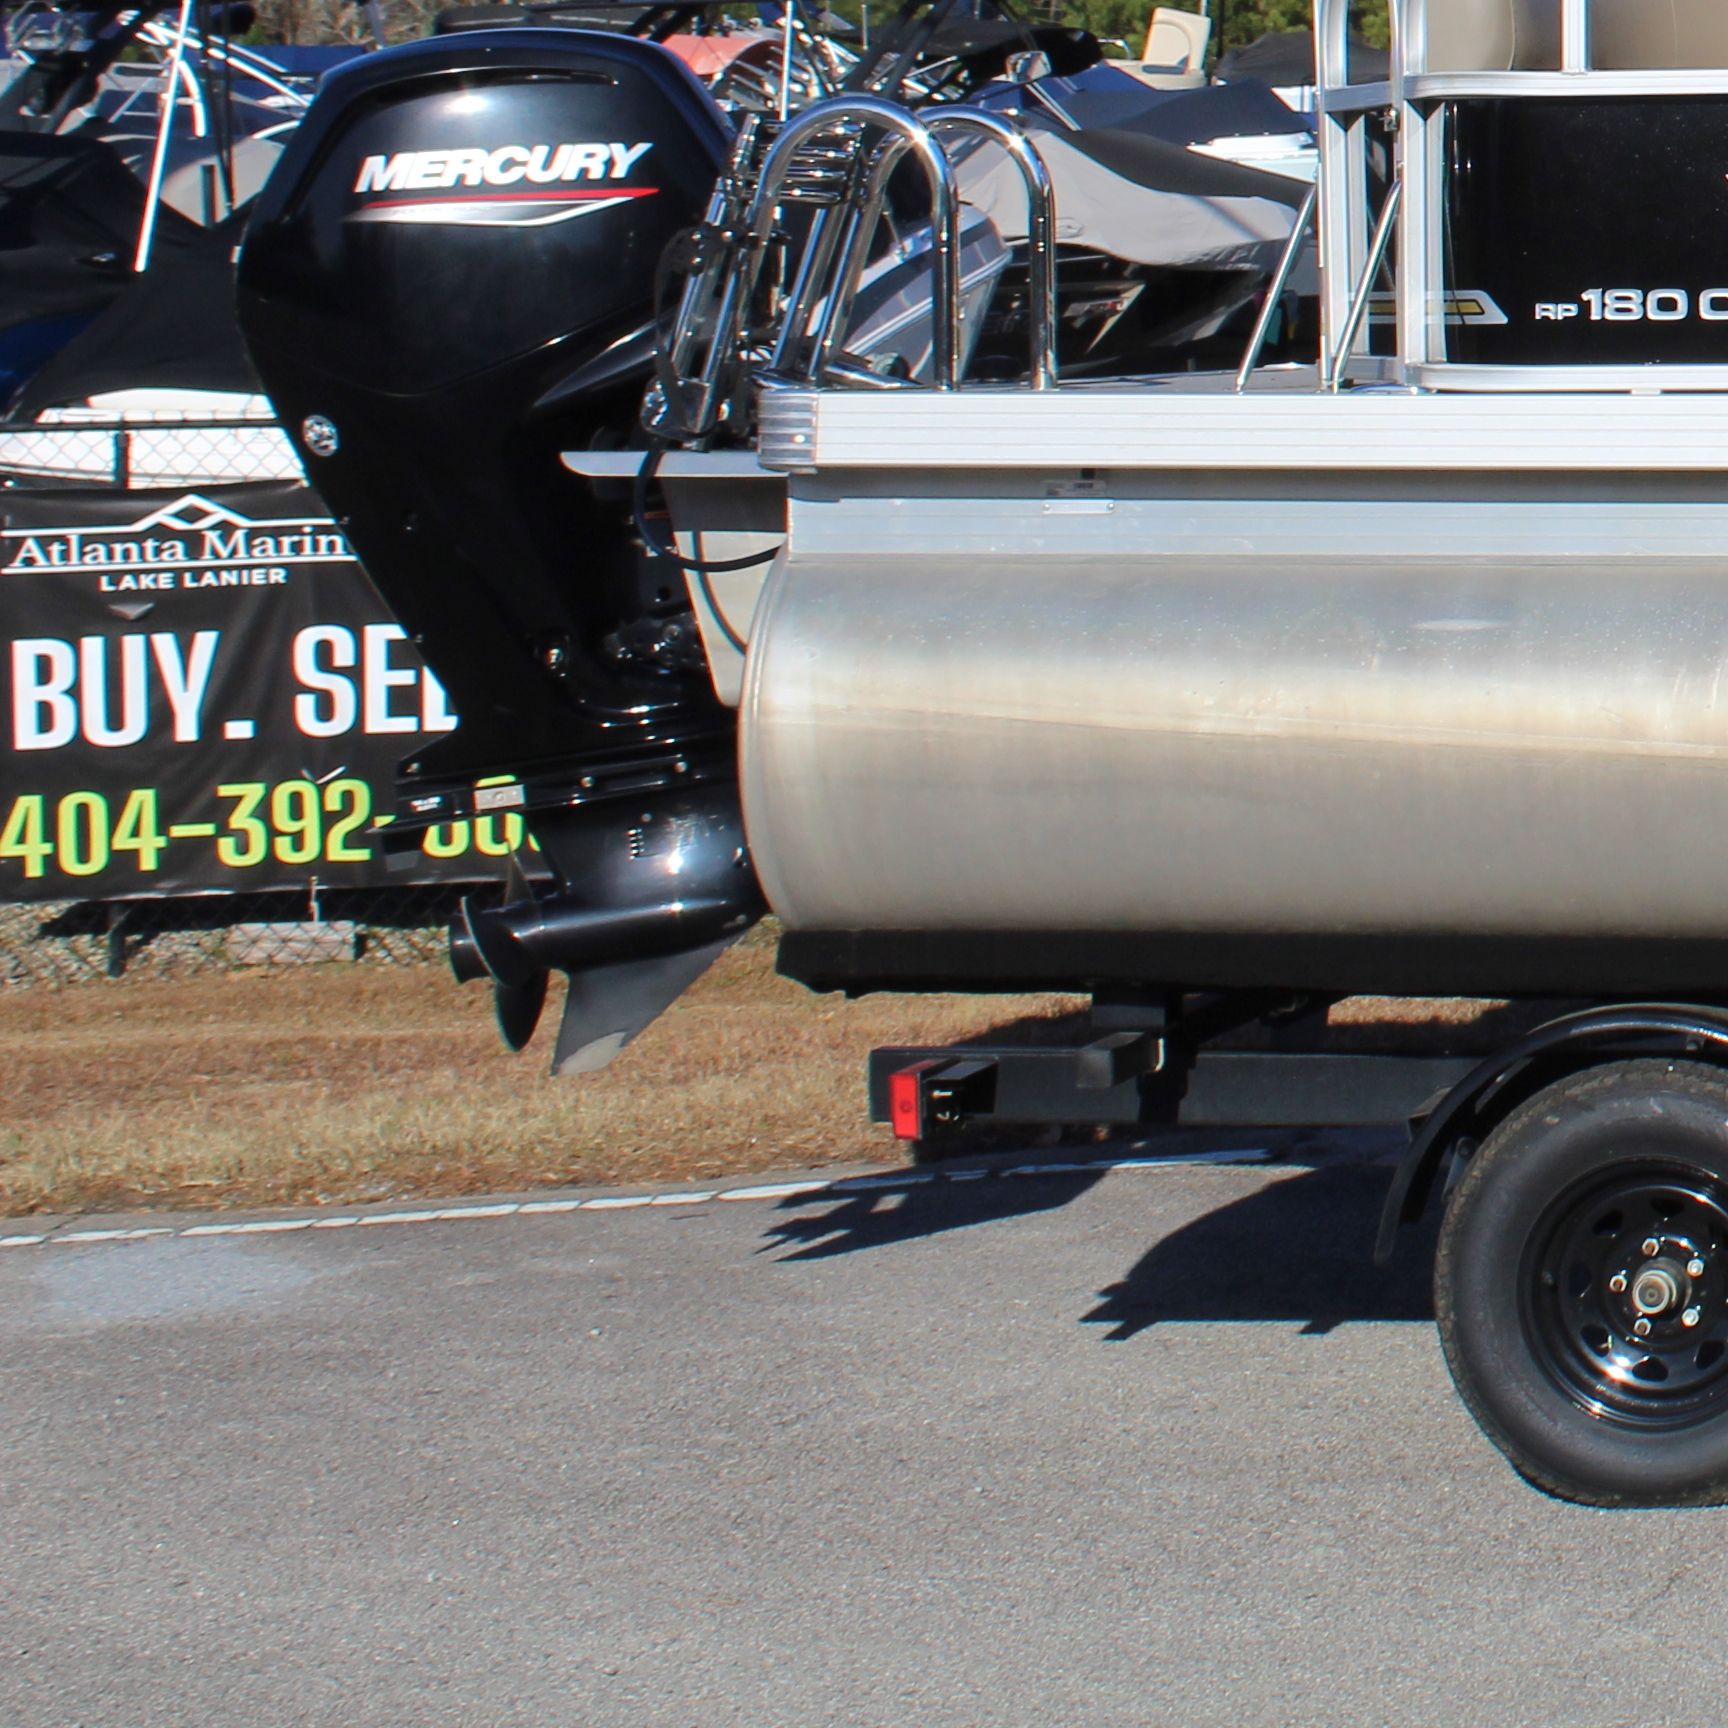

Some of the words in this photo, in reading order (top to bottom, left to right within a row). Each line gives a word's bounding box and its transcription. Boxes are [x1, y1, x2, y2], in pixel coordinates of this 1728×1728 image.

[354, 142, 654, 193] MERCURY
[8, 533, 190, 568] Atlanta
[201, 525, 348, 562] Marin
[99, 573, 176, 592] LAKE
[182, 568, 288, 589] LANIER
[11, 629, 255, 751] BUY.
[292, 623, 460, 739] SEL
